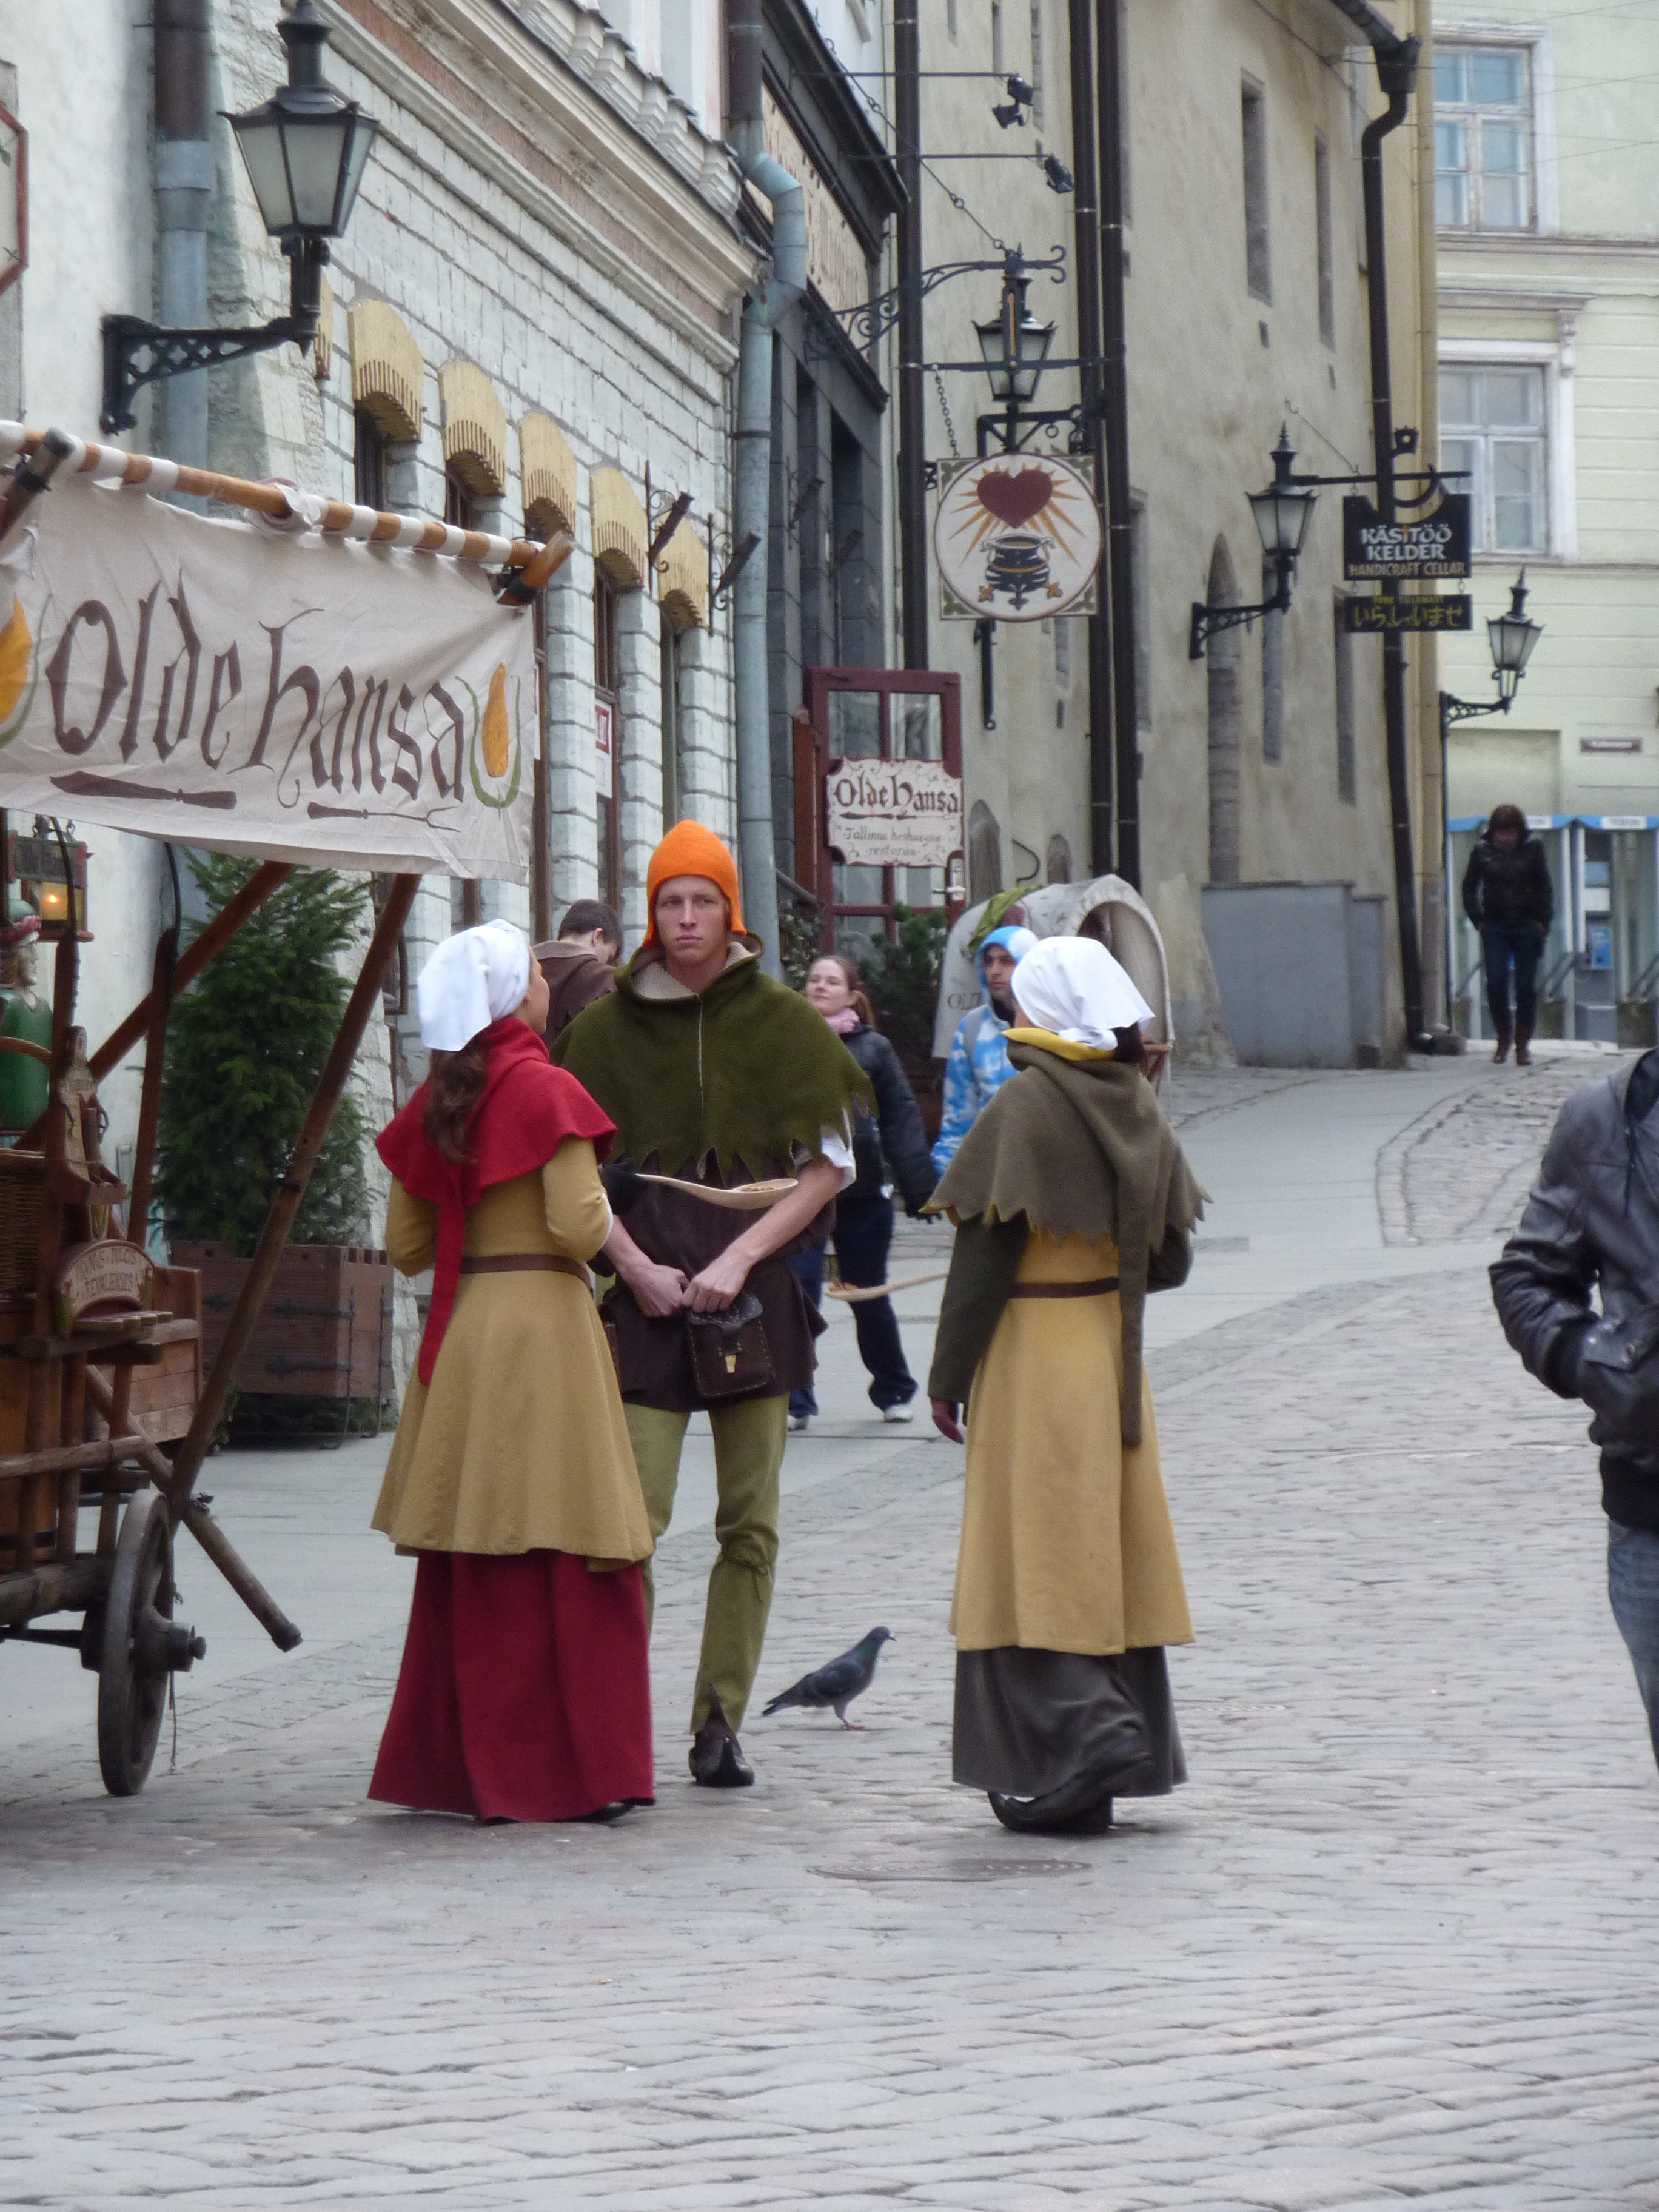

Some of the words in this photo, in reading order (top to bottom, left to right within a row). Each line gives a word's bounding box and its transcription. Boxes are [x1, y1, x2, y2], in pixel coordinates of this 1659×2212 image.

[1360, 523, 1453, 545] KÄSITÖÖ
[1366, 544, 1446, 561] KELDER
[1349, 561, 1421, 576] HANDICRAFT
[1425, 561, 1466, 575] CELLAR
[45, 567, 241, 770] Olde
[833, 770, 888, 808] Olde
